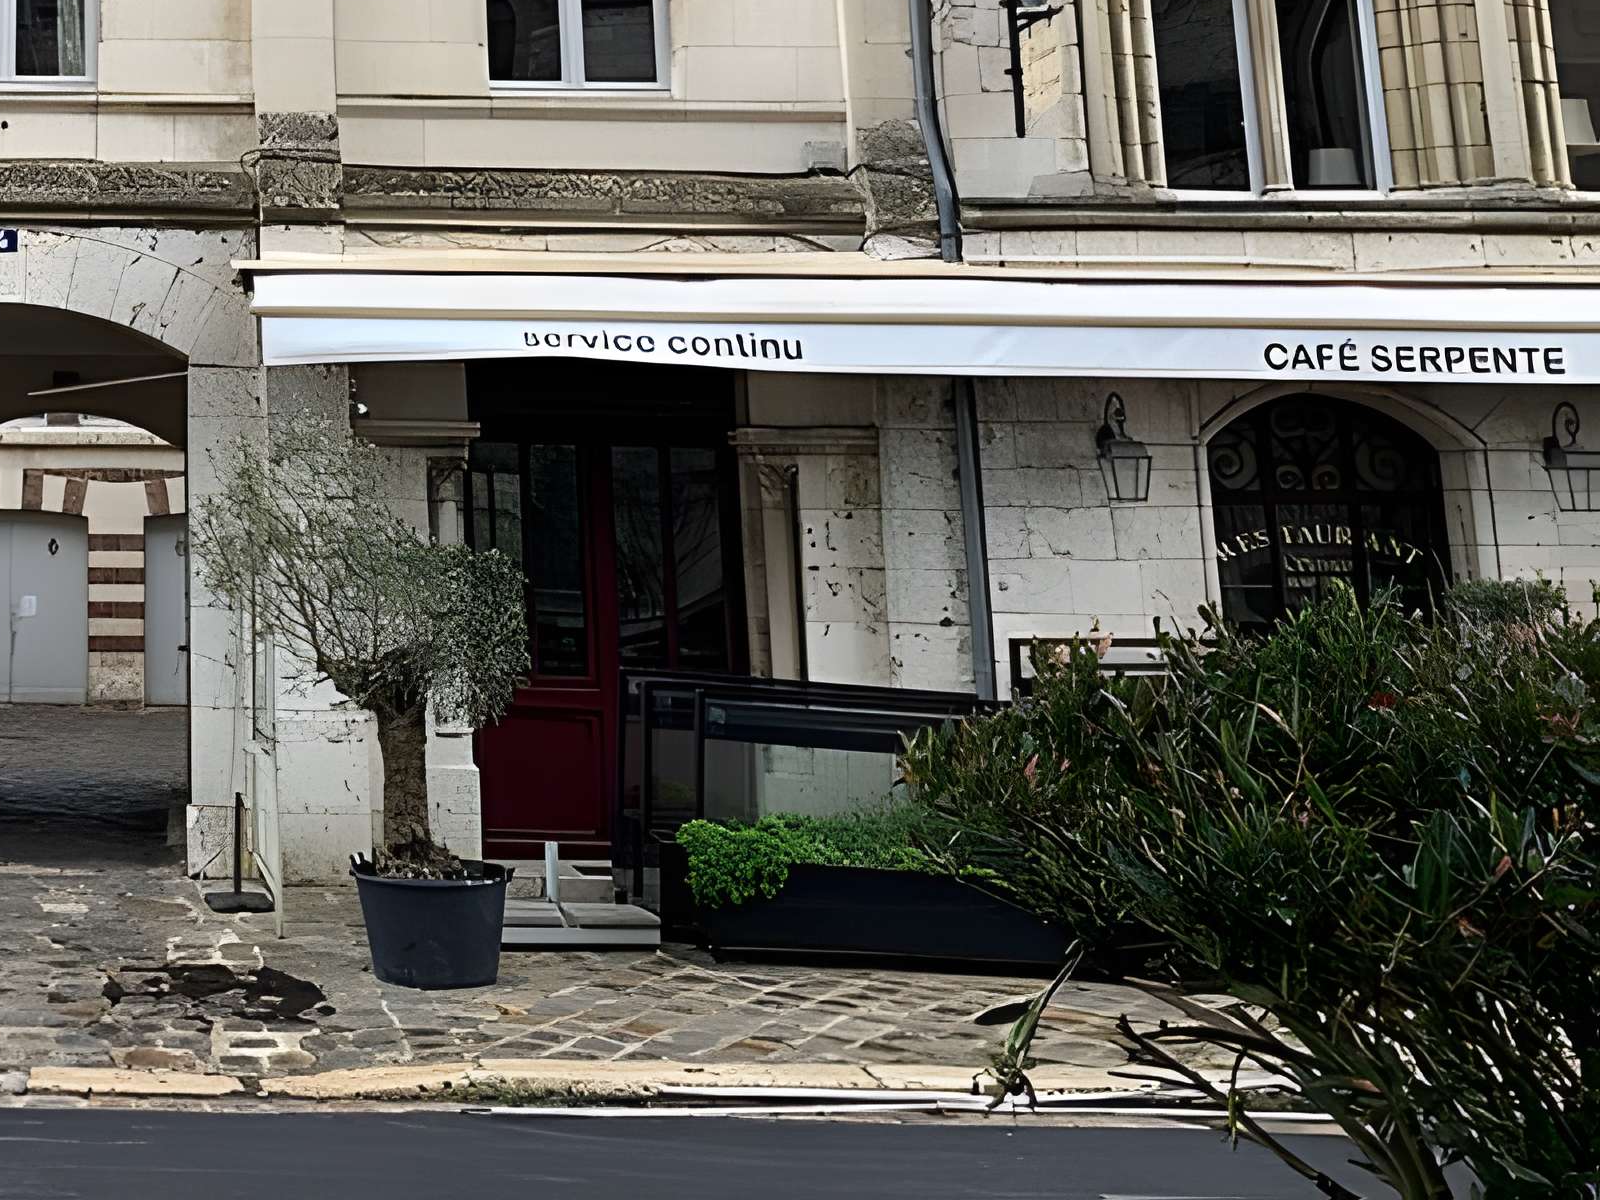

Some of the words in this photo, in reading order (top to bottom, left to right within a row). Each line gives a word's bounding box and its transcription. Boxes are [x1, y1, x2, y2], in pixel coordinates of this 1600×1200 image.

[668, 332, 803, 360] continu
[1263, 338, 1360, 371] CAFÉ
[1371, 345, 1566, 375] SERPENTE
